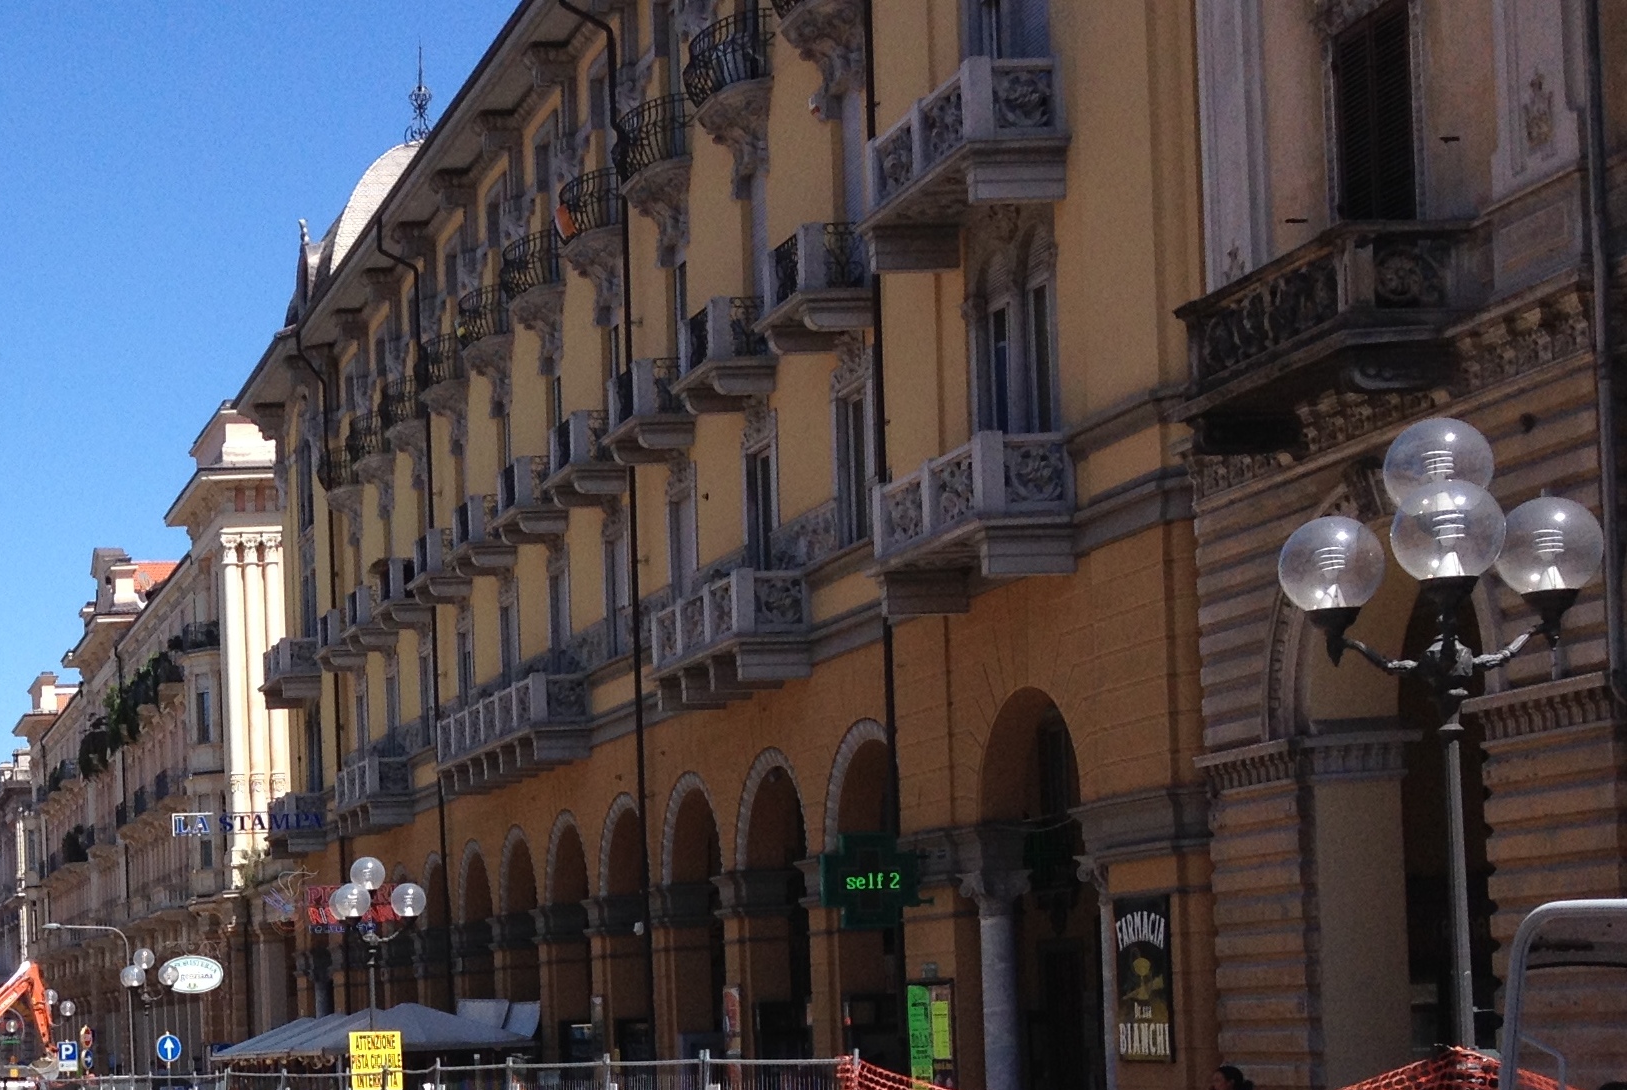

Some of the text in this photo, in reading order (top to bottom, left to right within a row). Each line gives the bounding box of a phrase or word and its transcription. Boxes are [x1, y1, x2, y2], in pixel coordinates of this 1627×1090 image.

[175, 812, 323, 836] LA STAMPA
[846, 872, 900, 890] self 2
[1116, 911, 1165, 951] FARMACIA
[356, 1034, 396, 1051] ATTENZIONE
[1119, 1023, 1170, 1056] BIANCHI
[61, 1044, 73, 1060] P
[351, 1054, 370, 1070] PISTA
